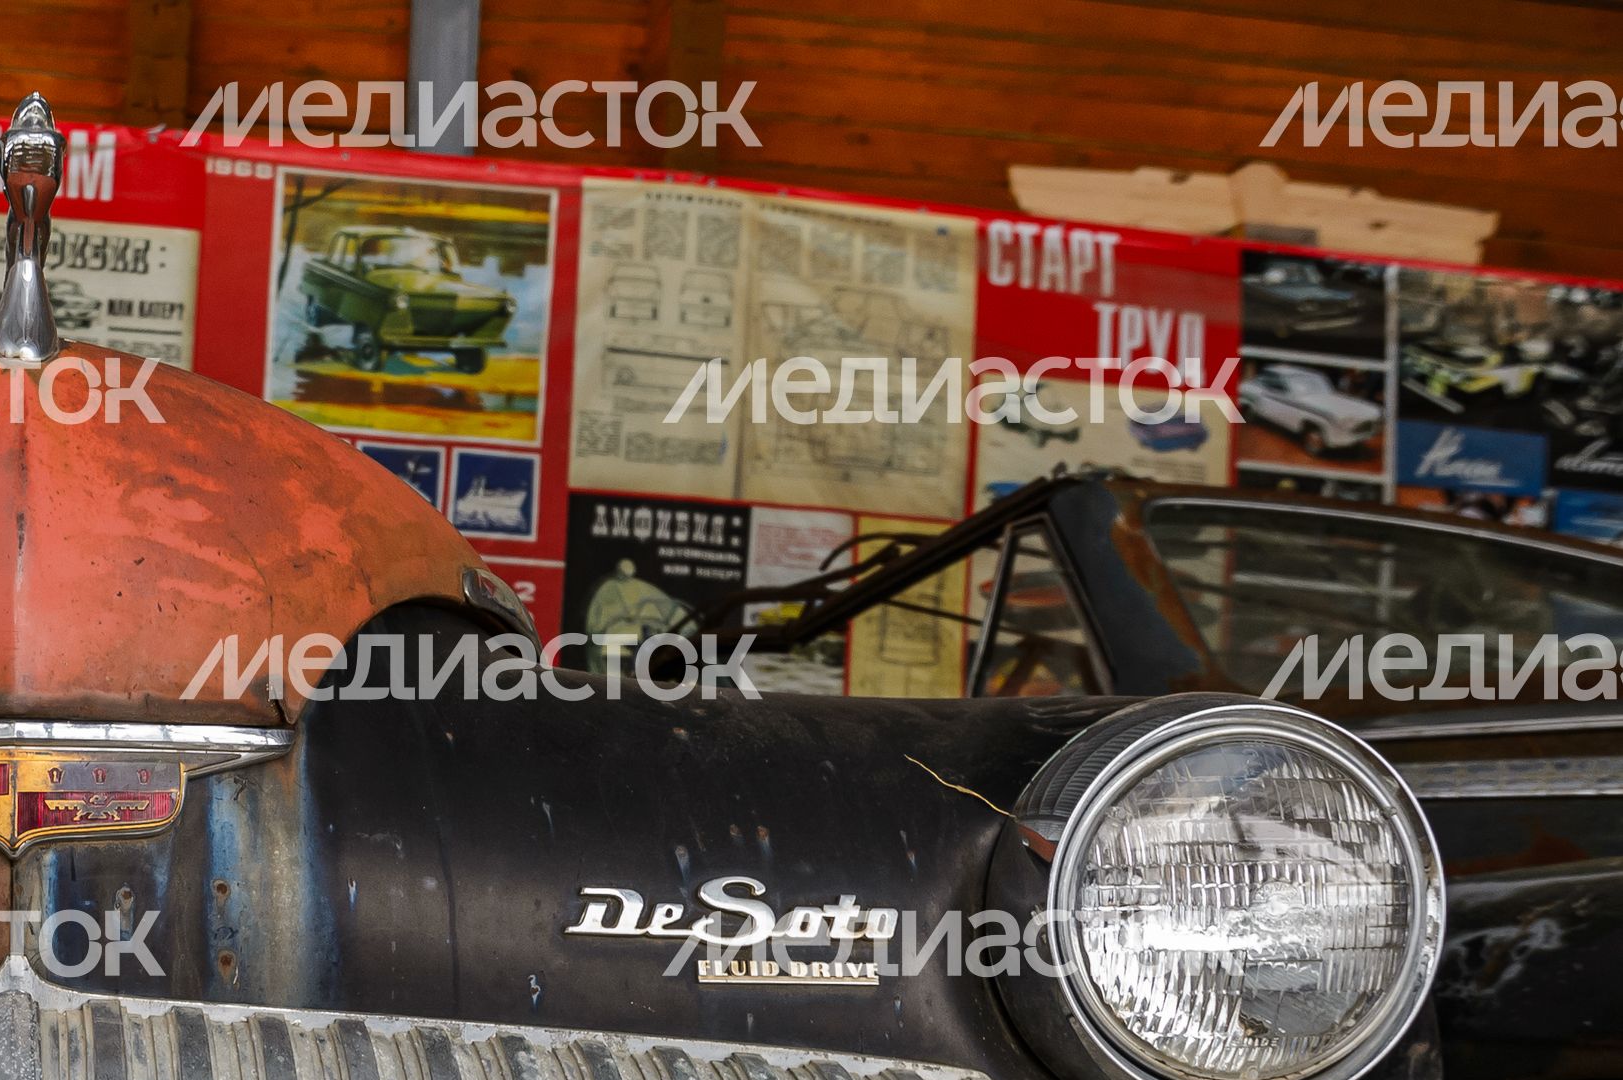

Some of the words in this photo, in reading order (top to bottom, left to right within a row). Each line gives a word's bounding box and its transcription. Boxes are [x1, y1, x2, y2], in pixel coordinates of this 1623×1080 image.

[986, 219, 1121, 298] СТАРТ
[1093, 301, 1207, 388] ТРУД
[698, 959, 780, 979] FLUID
[789, 960, 879, 980] DRIVE
